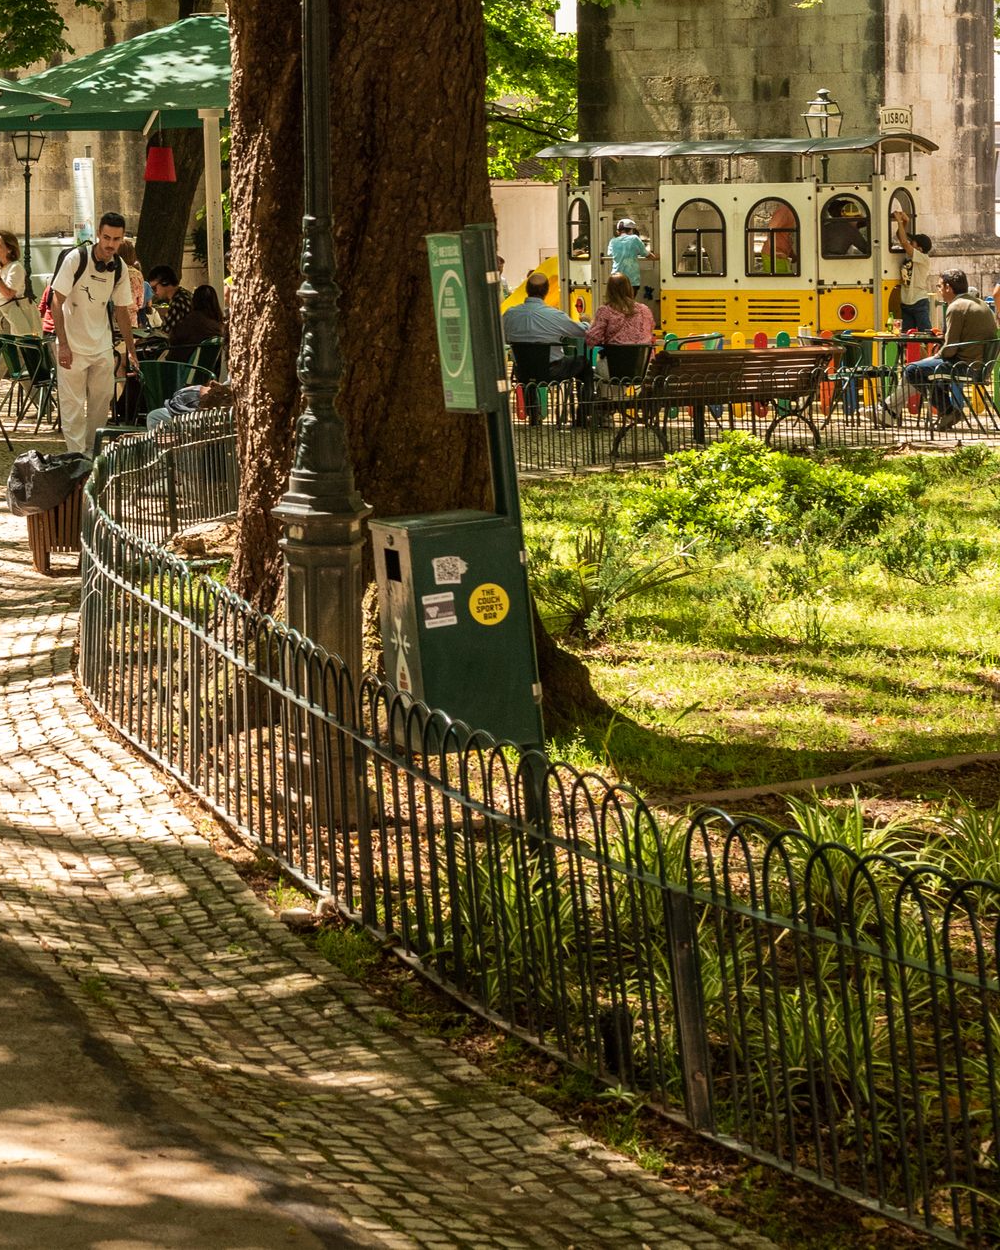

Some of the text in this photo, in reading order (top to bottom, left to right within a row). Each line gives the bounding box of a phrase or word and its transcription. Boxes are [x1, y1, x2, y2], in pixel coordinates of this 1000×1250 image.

[884, 112, 909, 125] LISBOA
[481, 588, 495, 596] THE
[477, 596, 501, 605] COUCH
[476, 604, 504, 613] SPORTS
[483, 612, 498, 621] BAR
